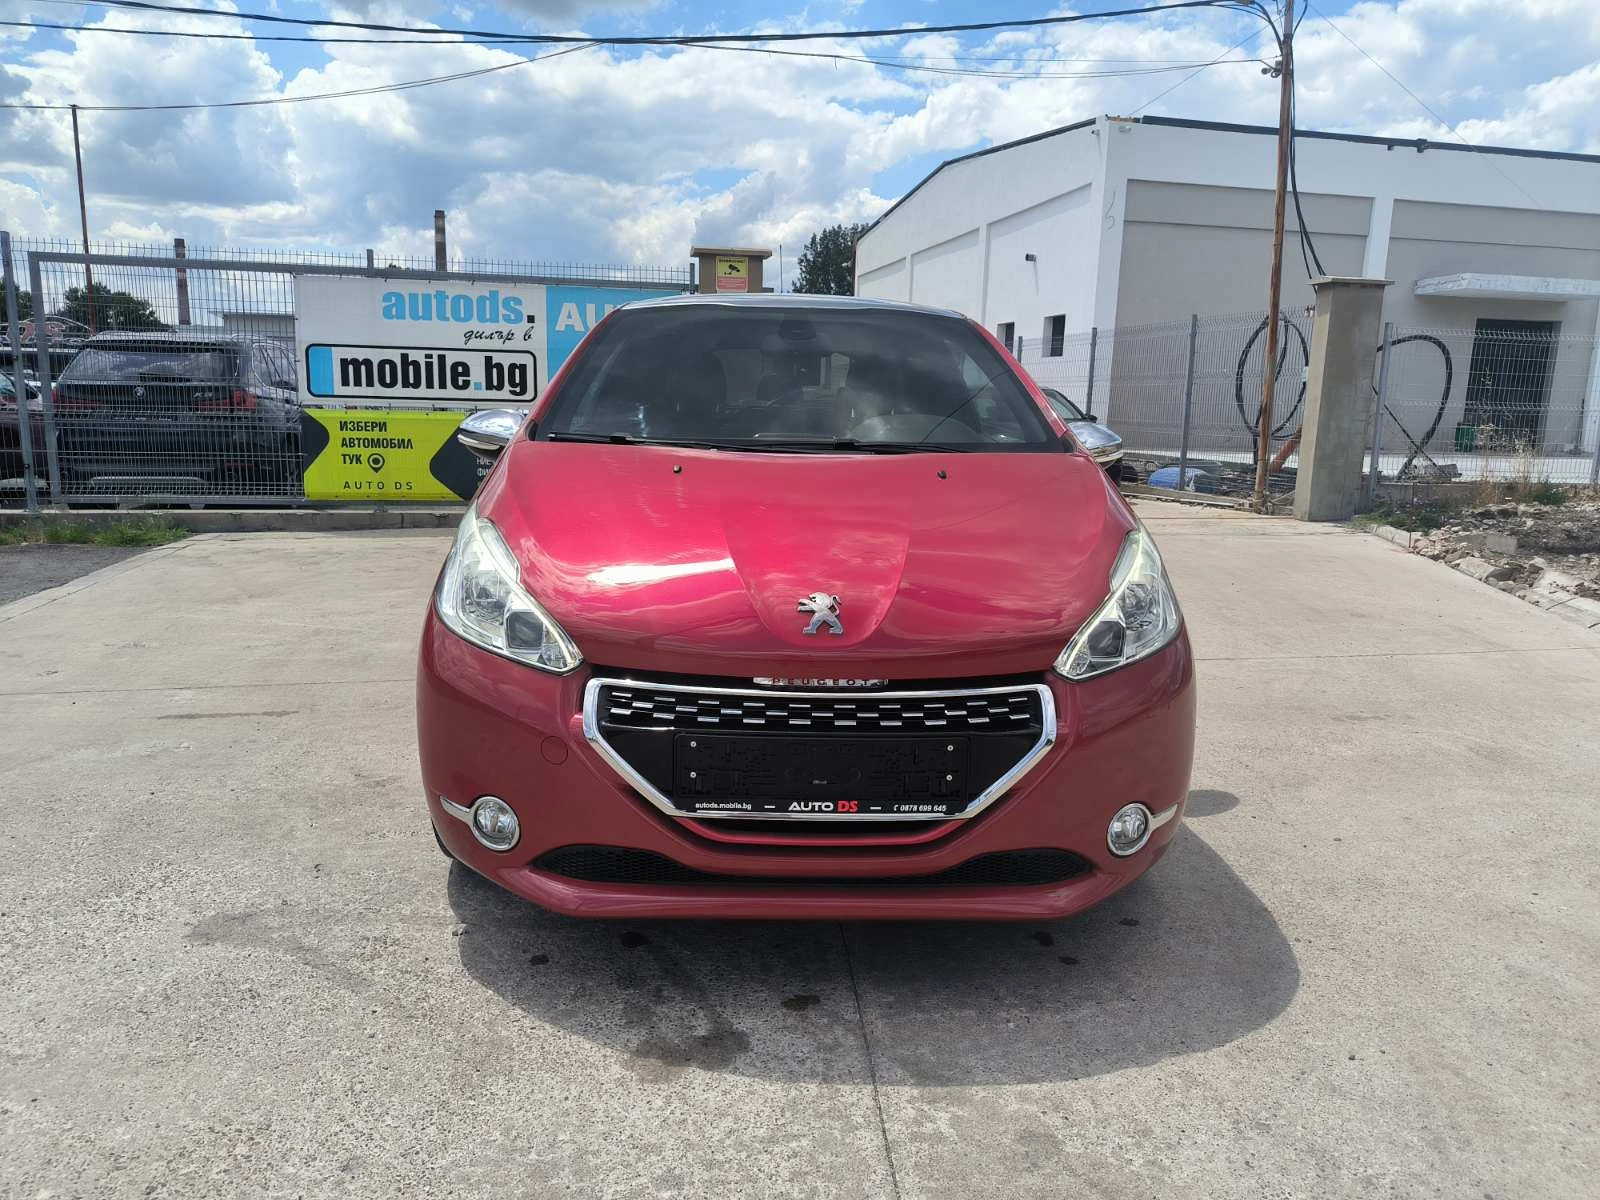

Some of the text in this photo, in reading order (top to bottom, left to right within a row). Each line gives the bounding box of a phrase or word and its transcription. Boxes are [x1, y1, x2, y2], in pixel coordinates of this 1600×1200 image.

[463, 326, 534, 345] дилър в
[339, 352, 528, 397] mobile.bg
[339, 420, 387, 433] ИЗБЕРИ
[341, 437, 414, 450] АВТОМОБИЛ
[341, 453, 363, 465] ТУК
[343, 481, 413, 490] AUTO DS
[772, 678, 868, 686] PEUGEOT
[788, 801, 834, 812] AUTO
[837, 800, 858, 812] DS
